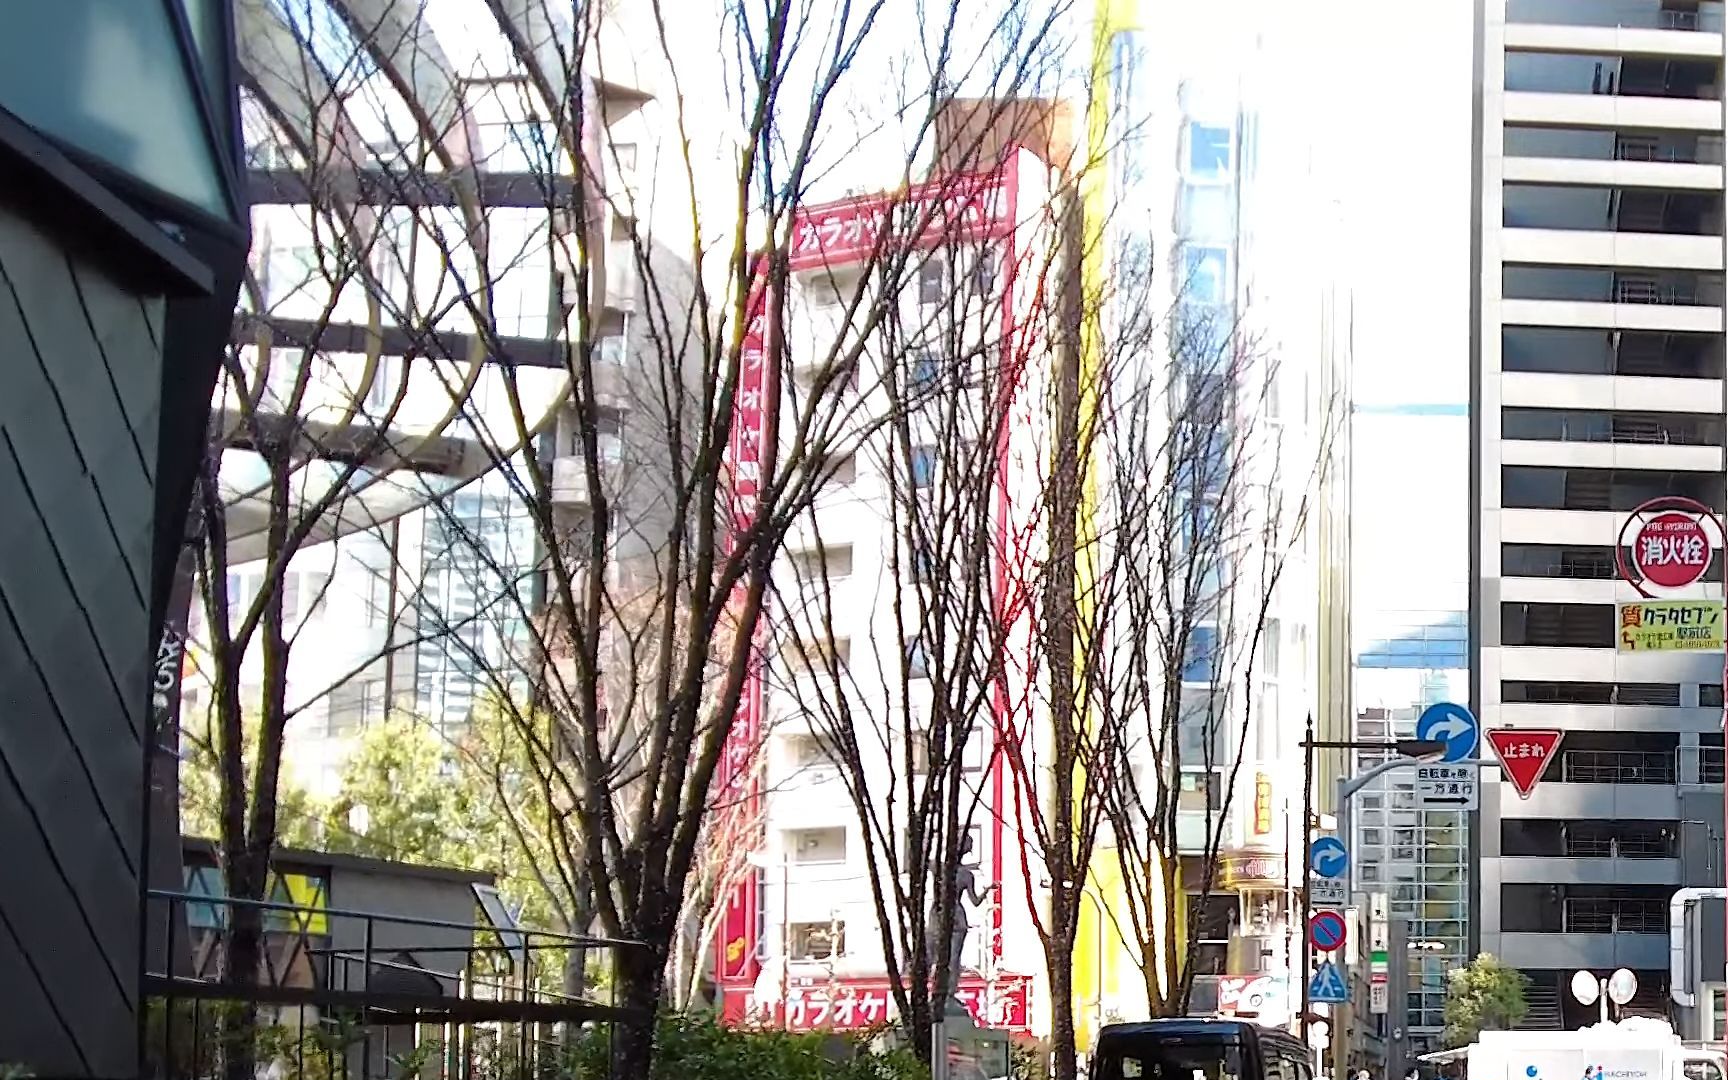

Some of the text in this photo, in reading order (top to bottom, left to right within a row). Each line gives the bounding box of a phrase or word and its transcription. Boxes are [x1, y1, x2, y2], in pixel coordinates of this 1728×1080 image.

[1641, 534, 1704, 566] 消火栓
[1503, 743, 1546, 759] 止まれ
[1420, 783, 1473, 795] 一方通行
